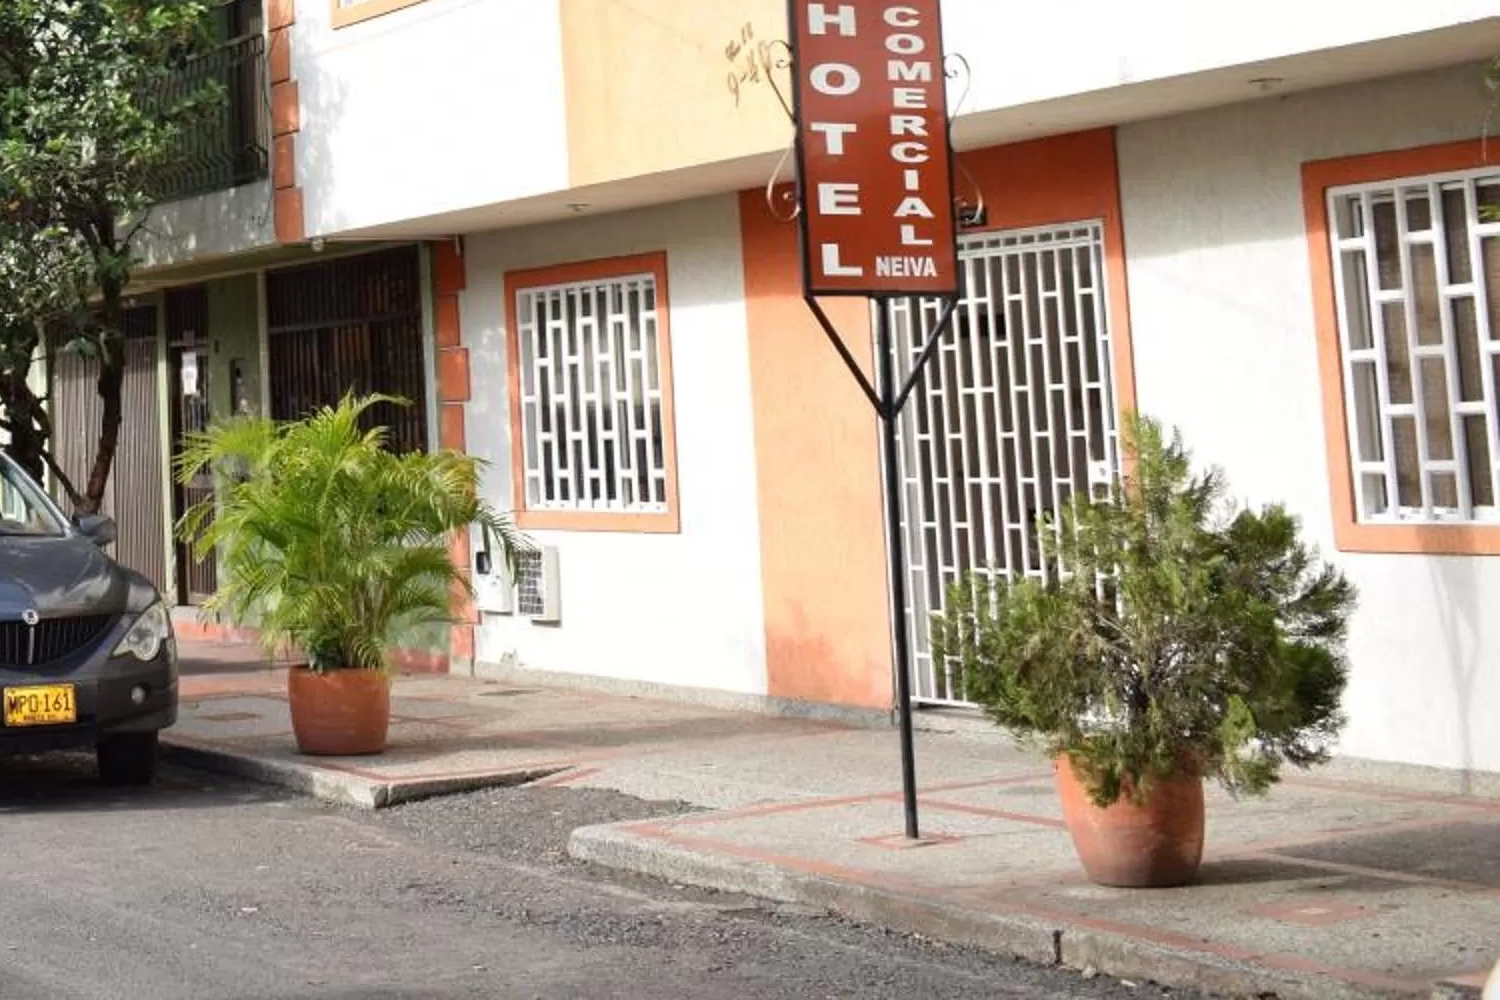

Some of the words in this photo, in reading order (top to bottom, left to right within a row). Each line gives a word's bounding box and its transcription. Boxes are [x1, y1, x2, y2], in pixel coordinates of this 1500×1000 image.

[807, 3, 863, 277] HOTEL
[883, 6, 934, 246] COMERCIAL
[875, 255, 937, 278] NEIVA
